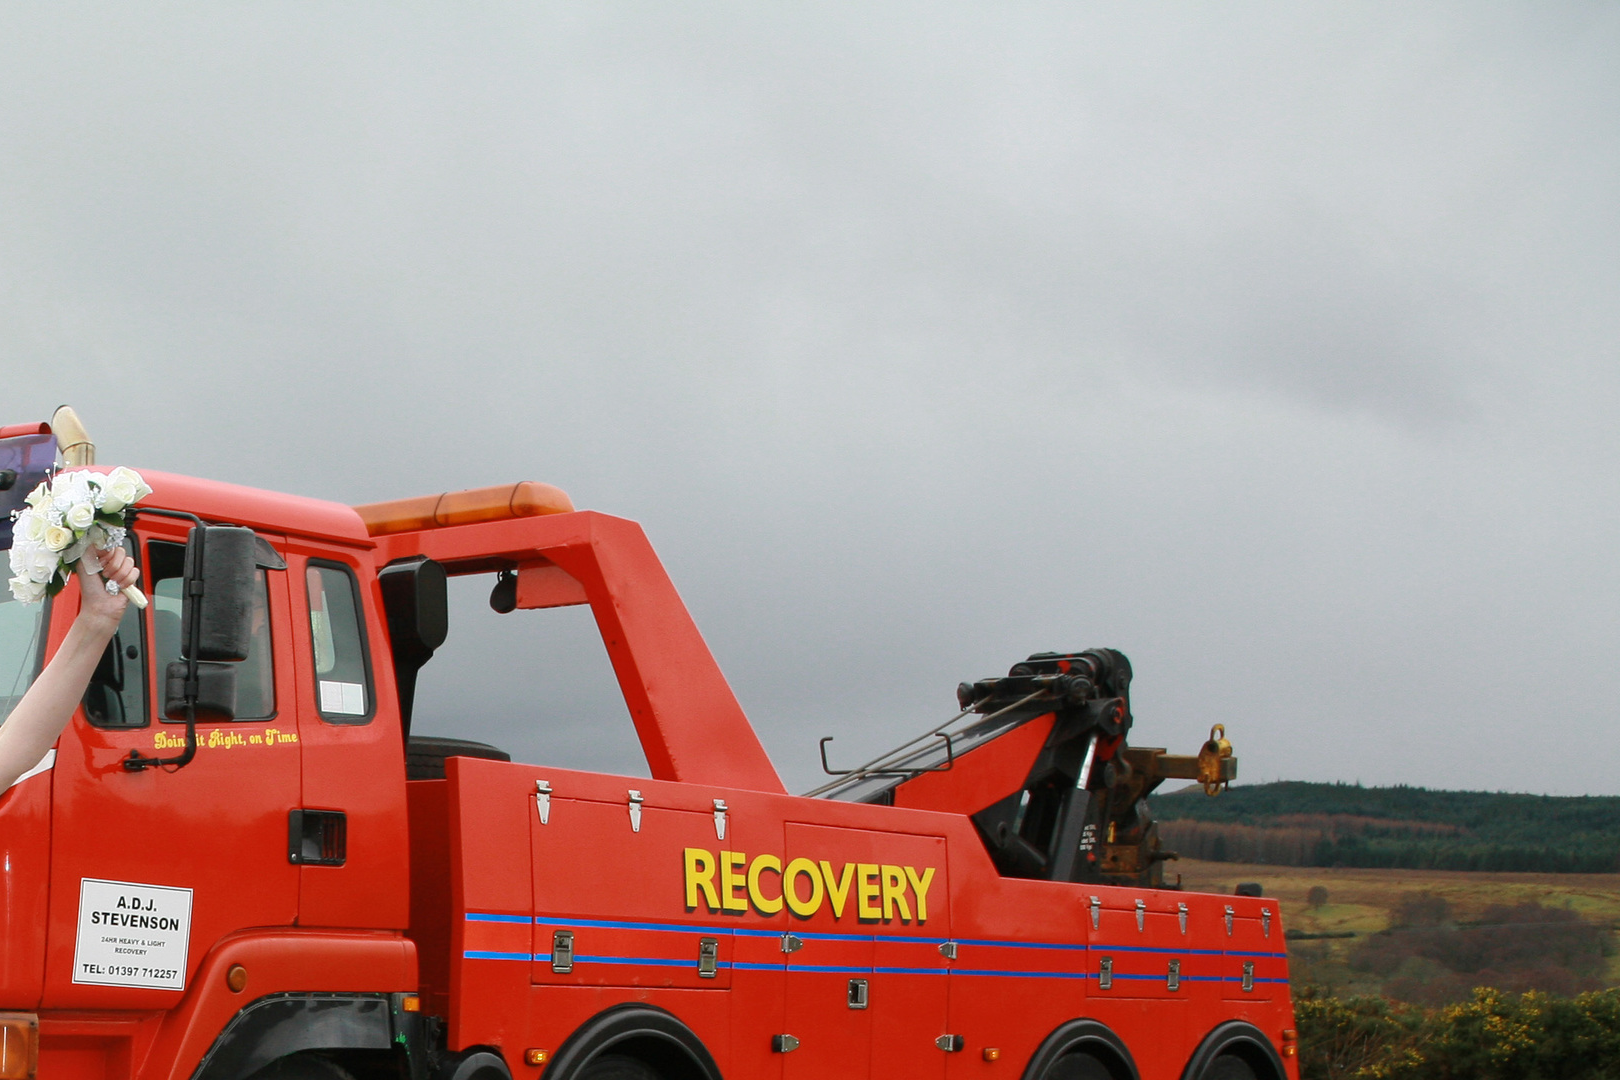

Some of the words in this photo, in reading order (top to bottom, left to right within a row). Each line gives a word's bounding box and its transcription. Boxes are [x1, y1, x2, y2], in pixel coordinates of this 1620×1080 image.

[154, 731, 188, 750] Doin
[195, 732, 205, 747] it
[208, 728, 247, 750] Right,
[249, 734, 262, 744] on
[265, 728, 298, 746] Time
[682, 847, 936, 927] RECOVERY
[116, 896, 157, 912] A.D.J.
[91, 911, 180, 931] STEVENSON
[118, 938, 140, 946] HEAVY
[114, 947, 148, 956] RECOVERY
[83, 964, 106, 975] TEL:
[108, 965, 140, 977] 01397
[142, 967, 178, 980] 712257
